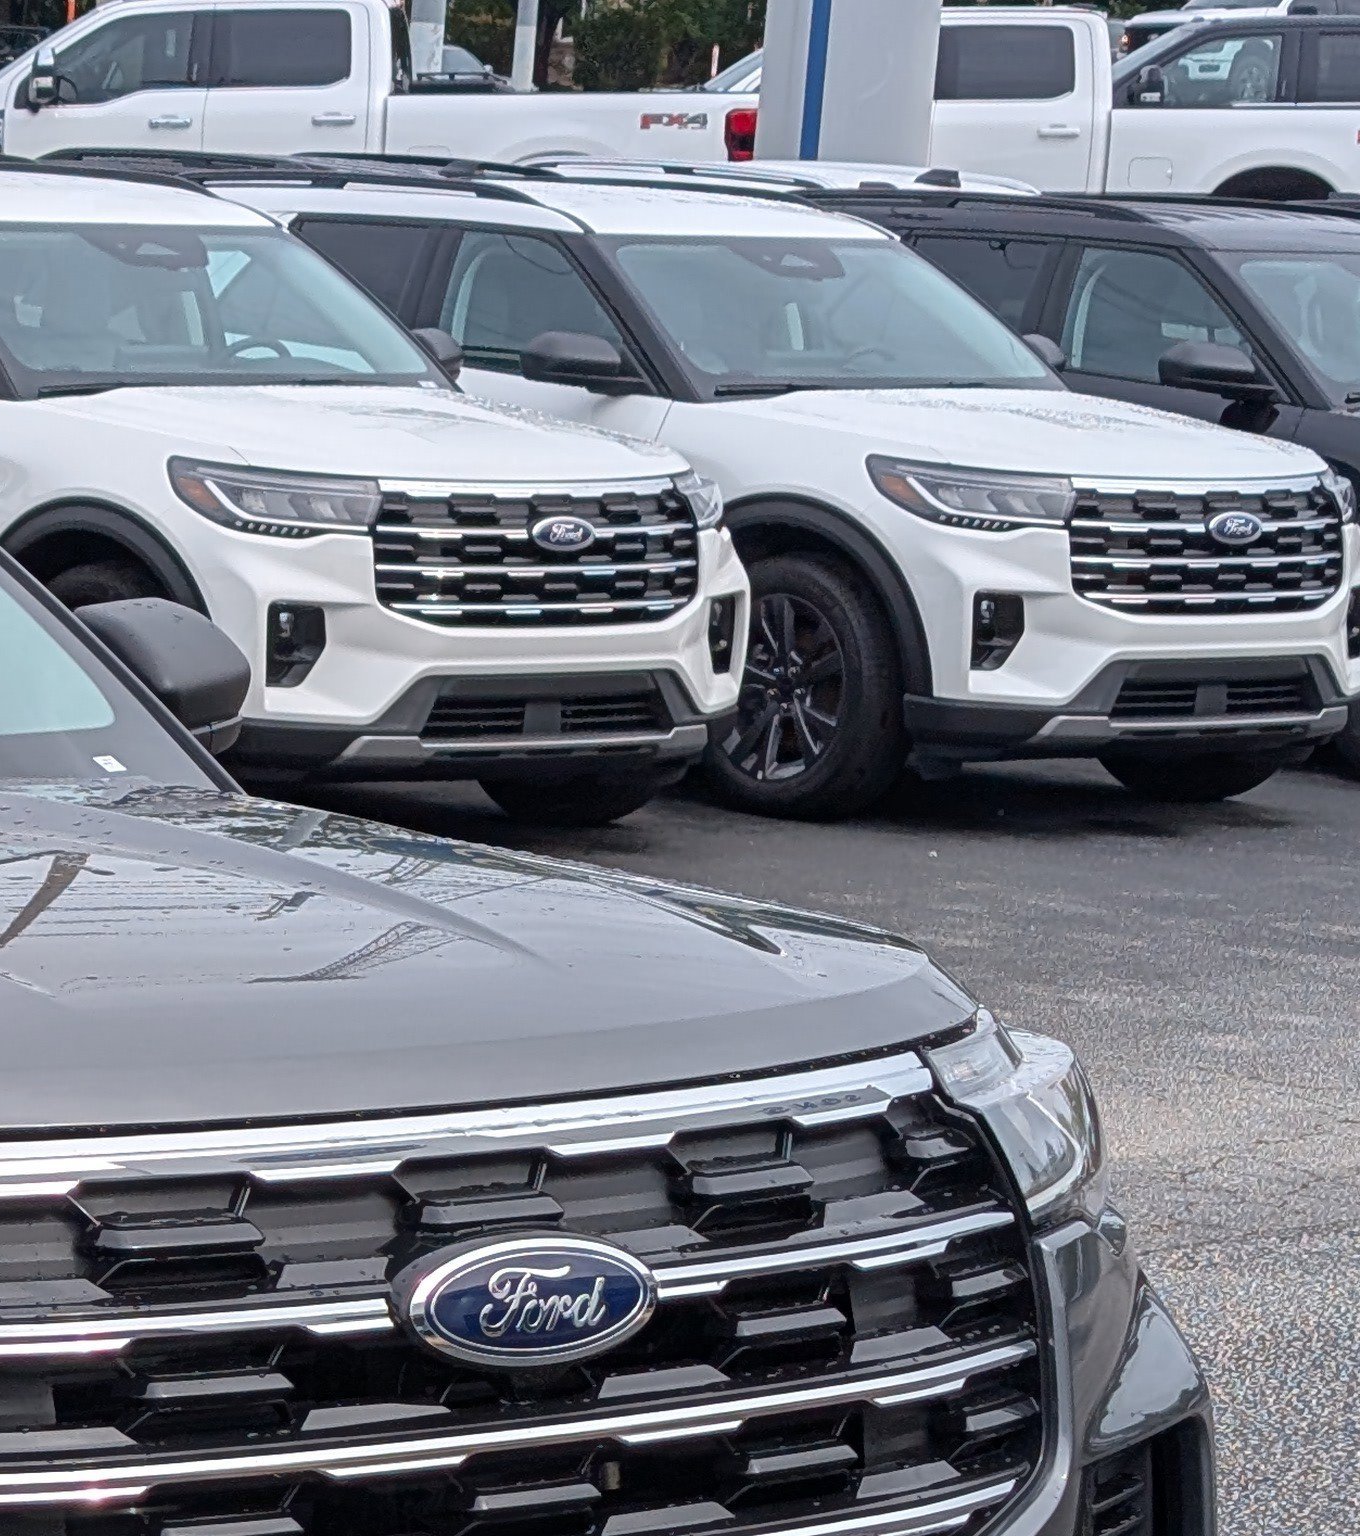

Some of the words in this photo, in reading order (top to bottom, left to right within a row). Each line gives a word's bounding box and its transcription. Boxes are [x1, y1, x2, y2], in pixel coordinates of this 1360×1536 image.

[640, 113, 708, 130] FX4
[550, 523, 584, 542] Ford
[1224, 518, 1253, 535] Ford
[481, 1265, 606, 1338] Ford
